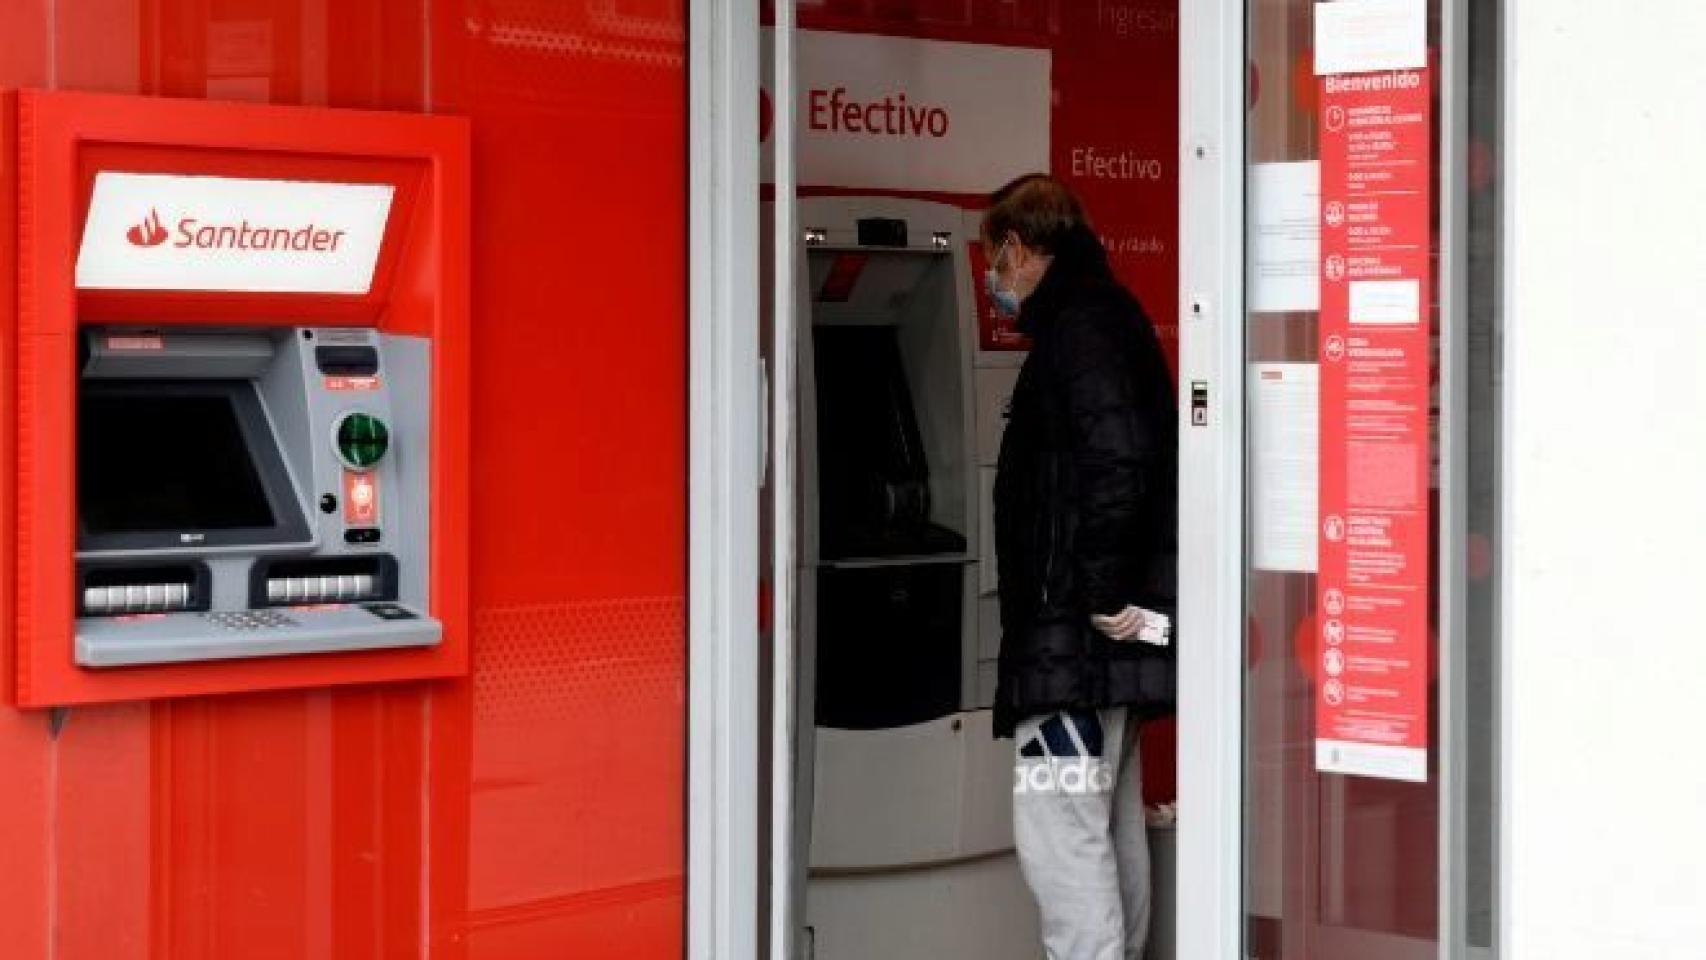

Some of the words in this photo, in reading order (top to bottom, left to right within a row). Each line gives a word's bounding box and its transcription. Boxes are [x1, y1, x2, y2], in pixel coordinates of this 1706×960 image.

[1325, 70, 1420, 94] Bienvenido
[808, 88, 950, 138] Efectivo
[1072, 146, 1161, 180] Efectivo
[174, 217, 347, 252] Santander
